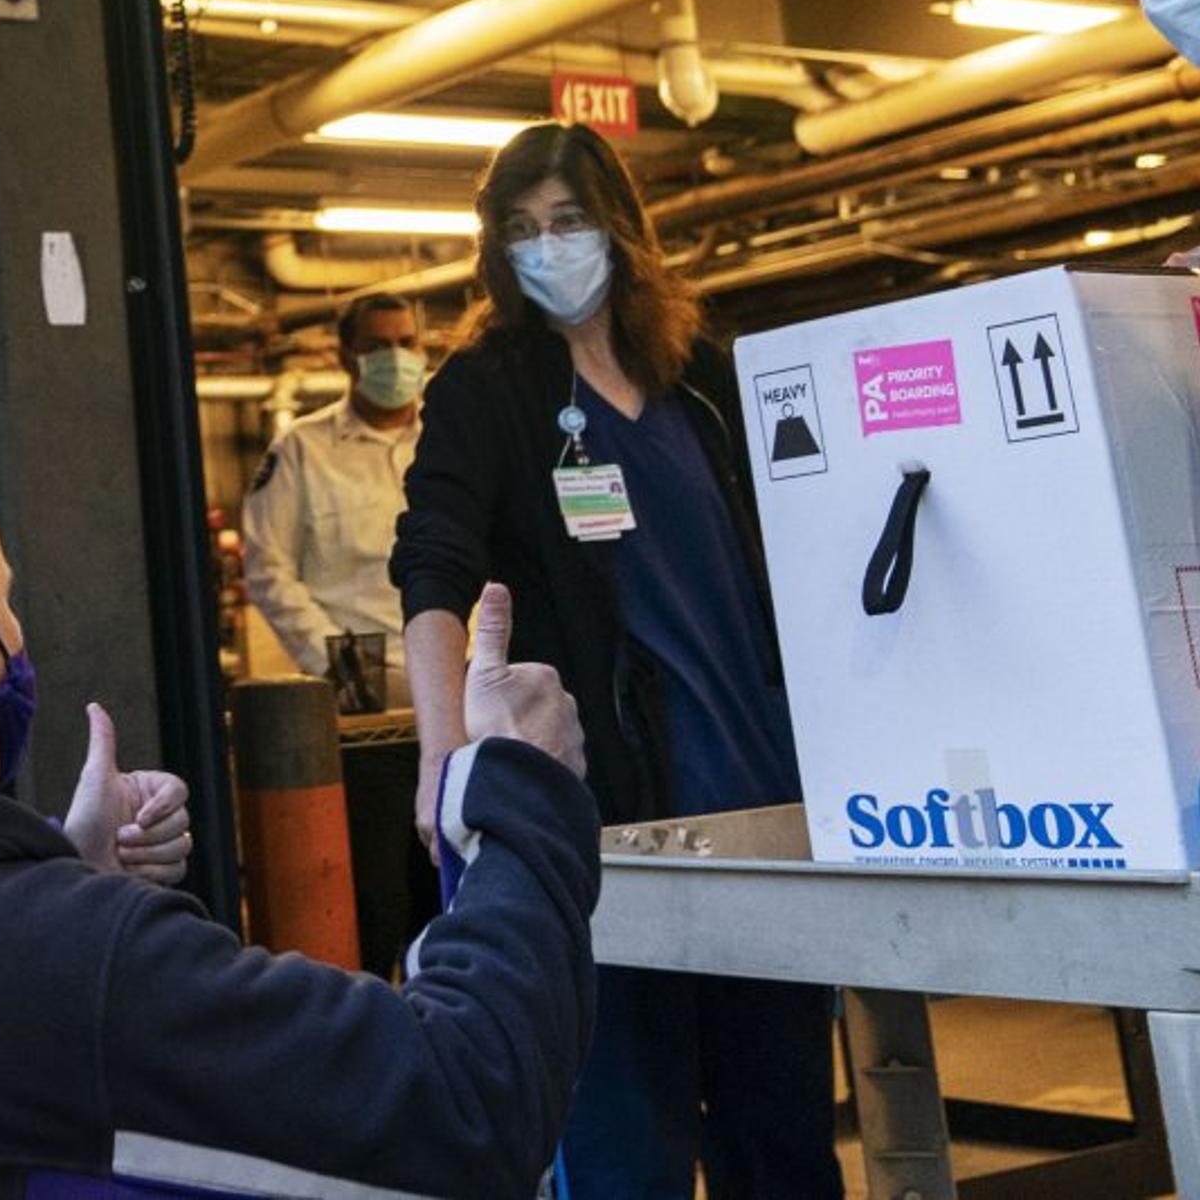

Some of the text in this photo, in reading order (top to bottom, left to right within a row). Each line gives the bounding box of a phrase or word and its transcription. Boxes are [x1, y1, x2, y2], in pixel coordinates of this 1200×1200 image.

[573, 83, 631, 125] EXIT
[888, 365, 944, 382] PRIORITY
[763, 383, 807, 405] HEAVY
[862, 373, 889, 422] PA
[890, 383, 955, 402] BOARDING
[845, 788, 1123, 849] Softbox
